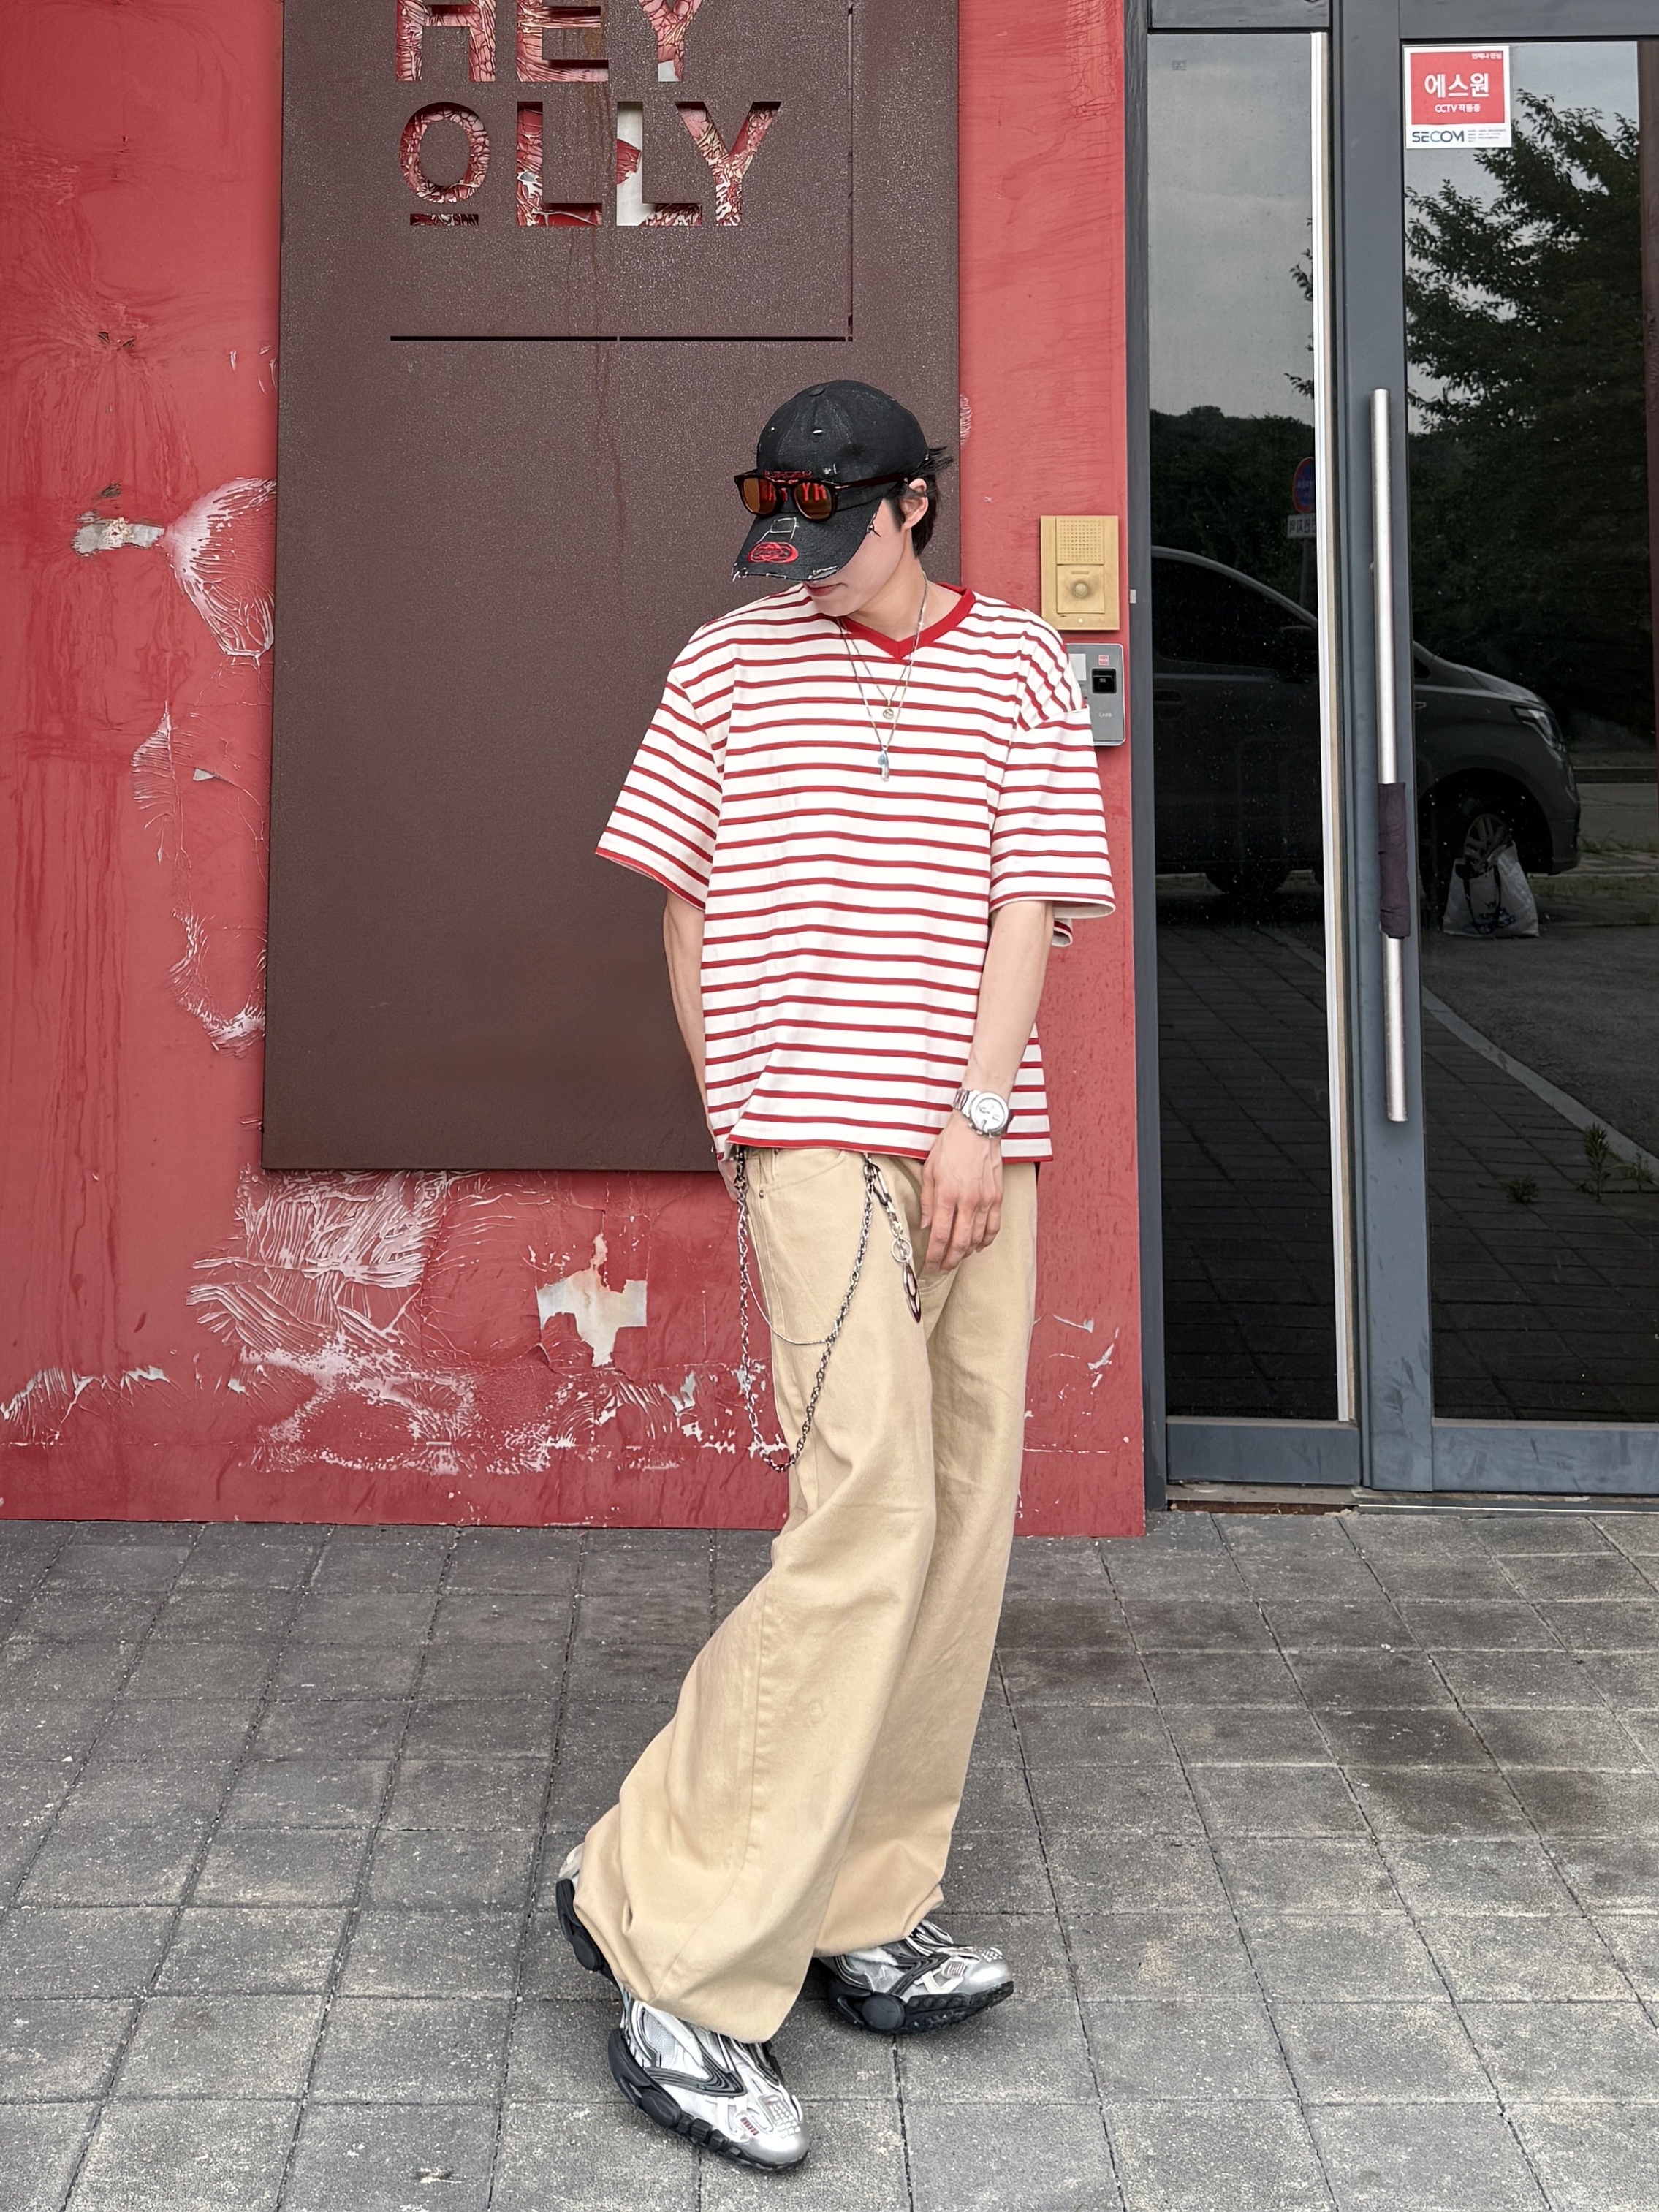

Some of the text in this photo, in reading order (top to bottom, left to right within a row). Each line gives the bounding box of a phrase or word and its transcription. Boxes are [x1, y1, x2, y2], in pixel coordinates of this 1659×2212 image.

[396, 0, 702, 83] HEY
[1424, 72, 1490, 98] 에스원
[1435, 103, 1481, 113] CCTV 작동중
[1412, 130, 1465, 143] SECOM
[399, 101, 782, 227] OLLY
